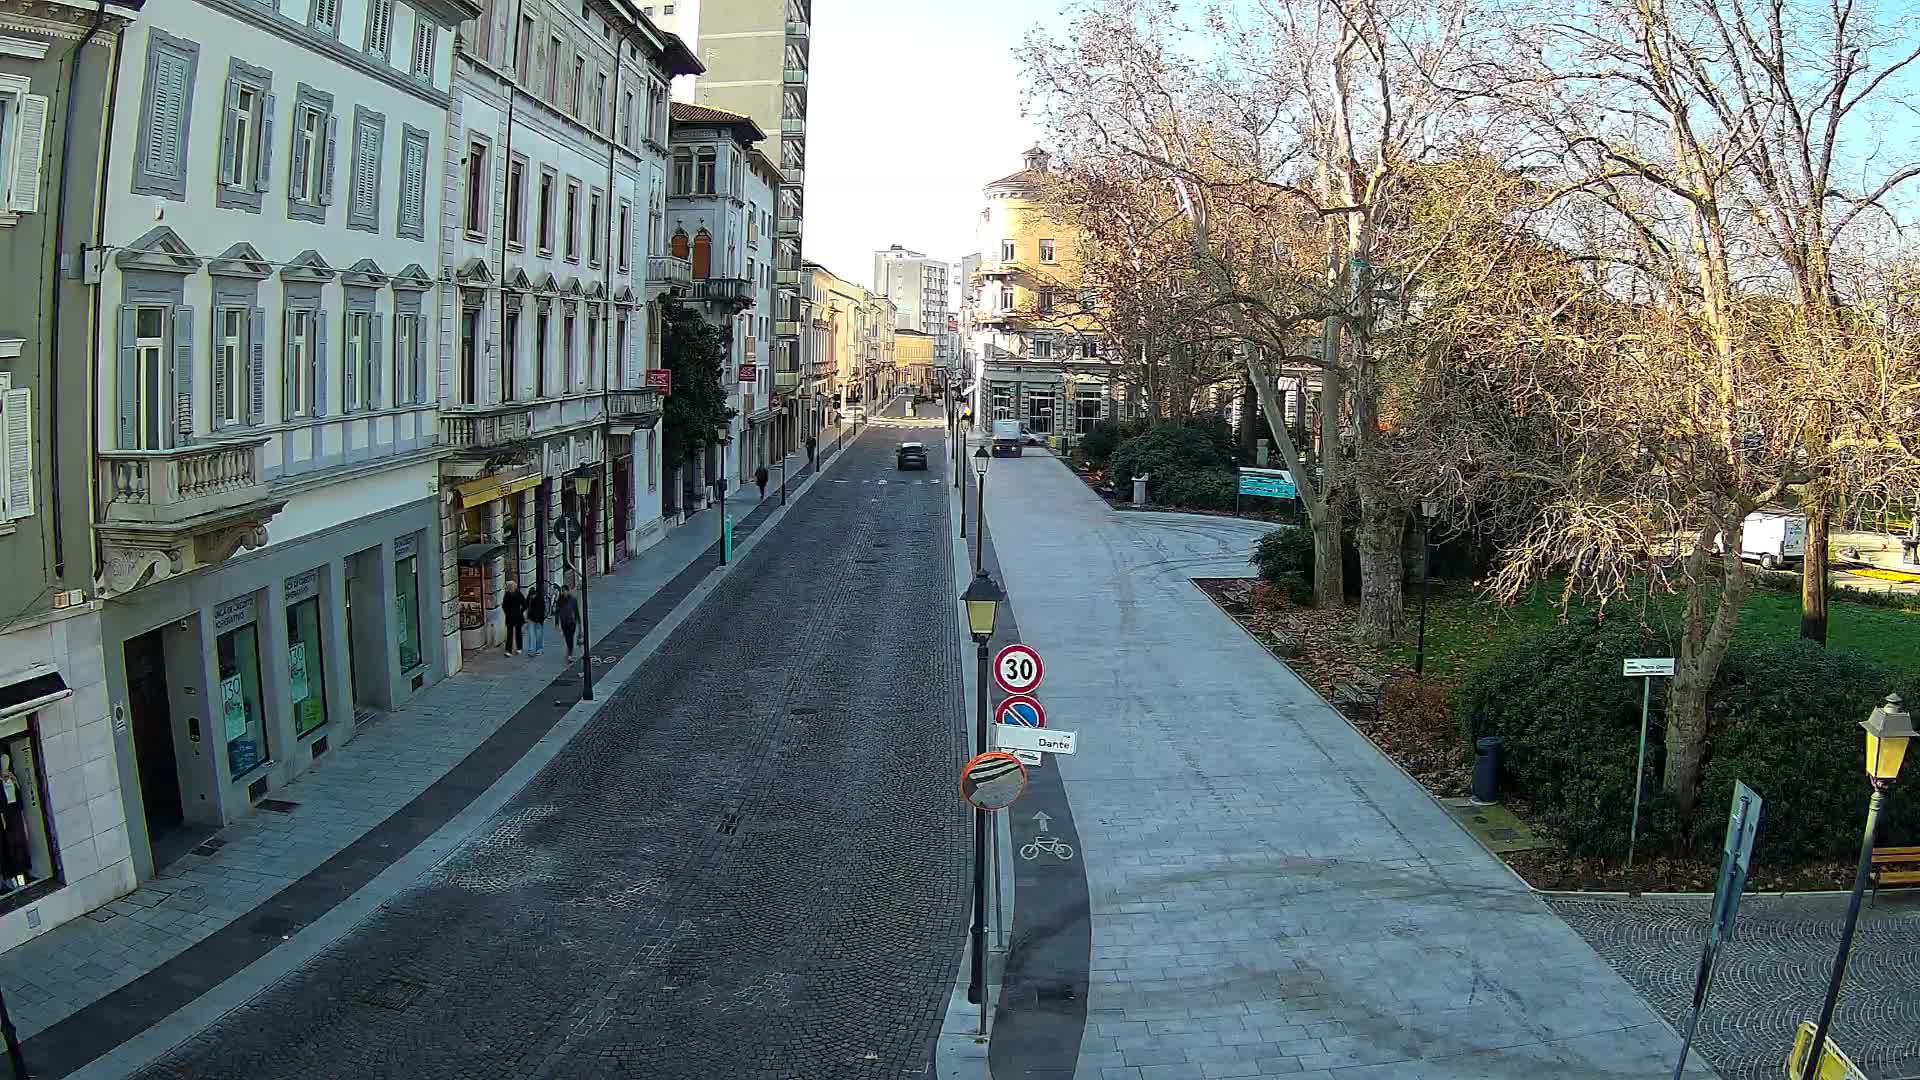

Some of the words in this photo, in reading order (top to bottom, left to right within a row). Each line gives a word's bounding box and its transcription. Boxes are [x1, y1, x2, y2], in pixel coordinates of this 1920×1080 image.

[1005, 658, 1033, 681] 30
[223, 678, 241, 701] 130
[1038, 738, 1070, 749] Dante
